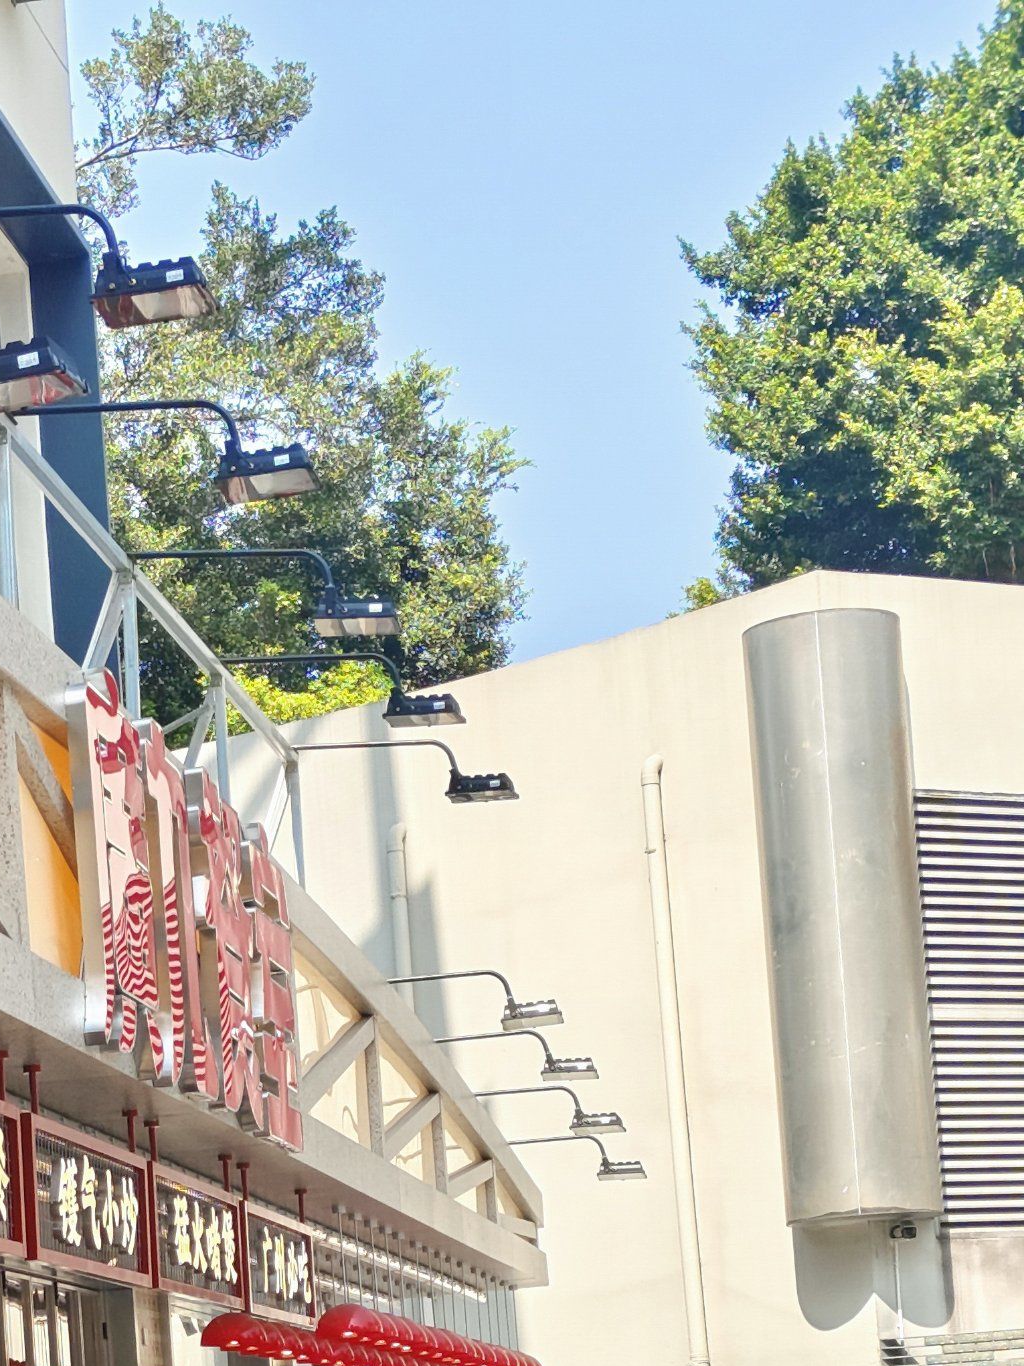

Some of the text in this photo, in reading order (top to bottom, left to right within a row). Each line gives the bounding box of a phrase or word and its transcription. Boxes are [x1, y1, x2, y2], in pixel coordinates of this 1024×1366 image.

[57, 1154, 139, 1256] 镬气小炒
[173, 1193, 238, 1285] 猛火啫煲
